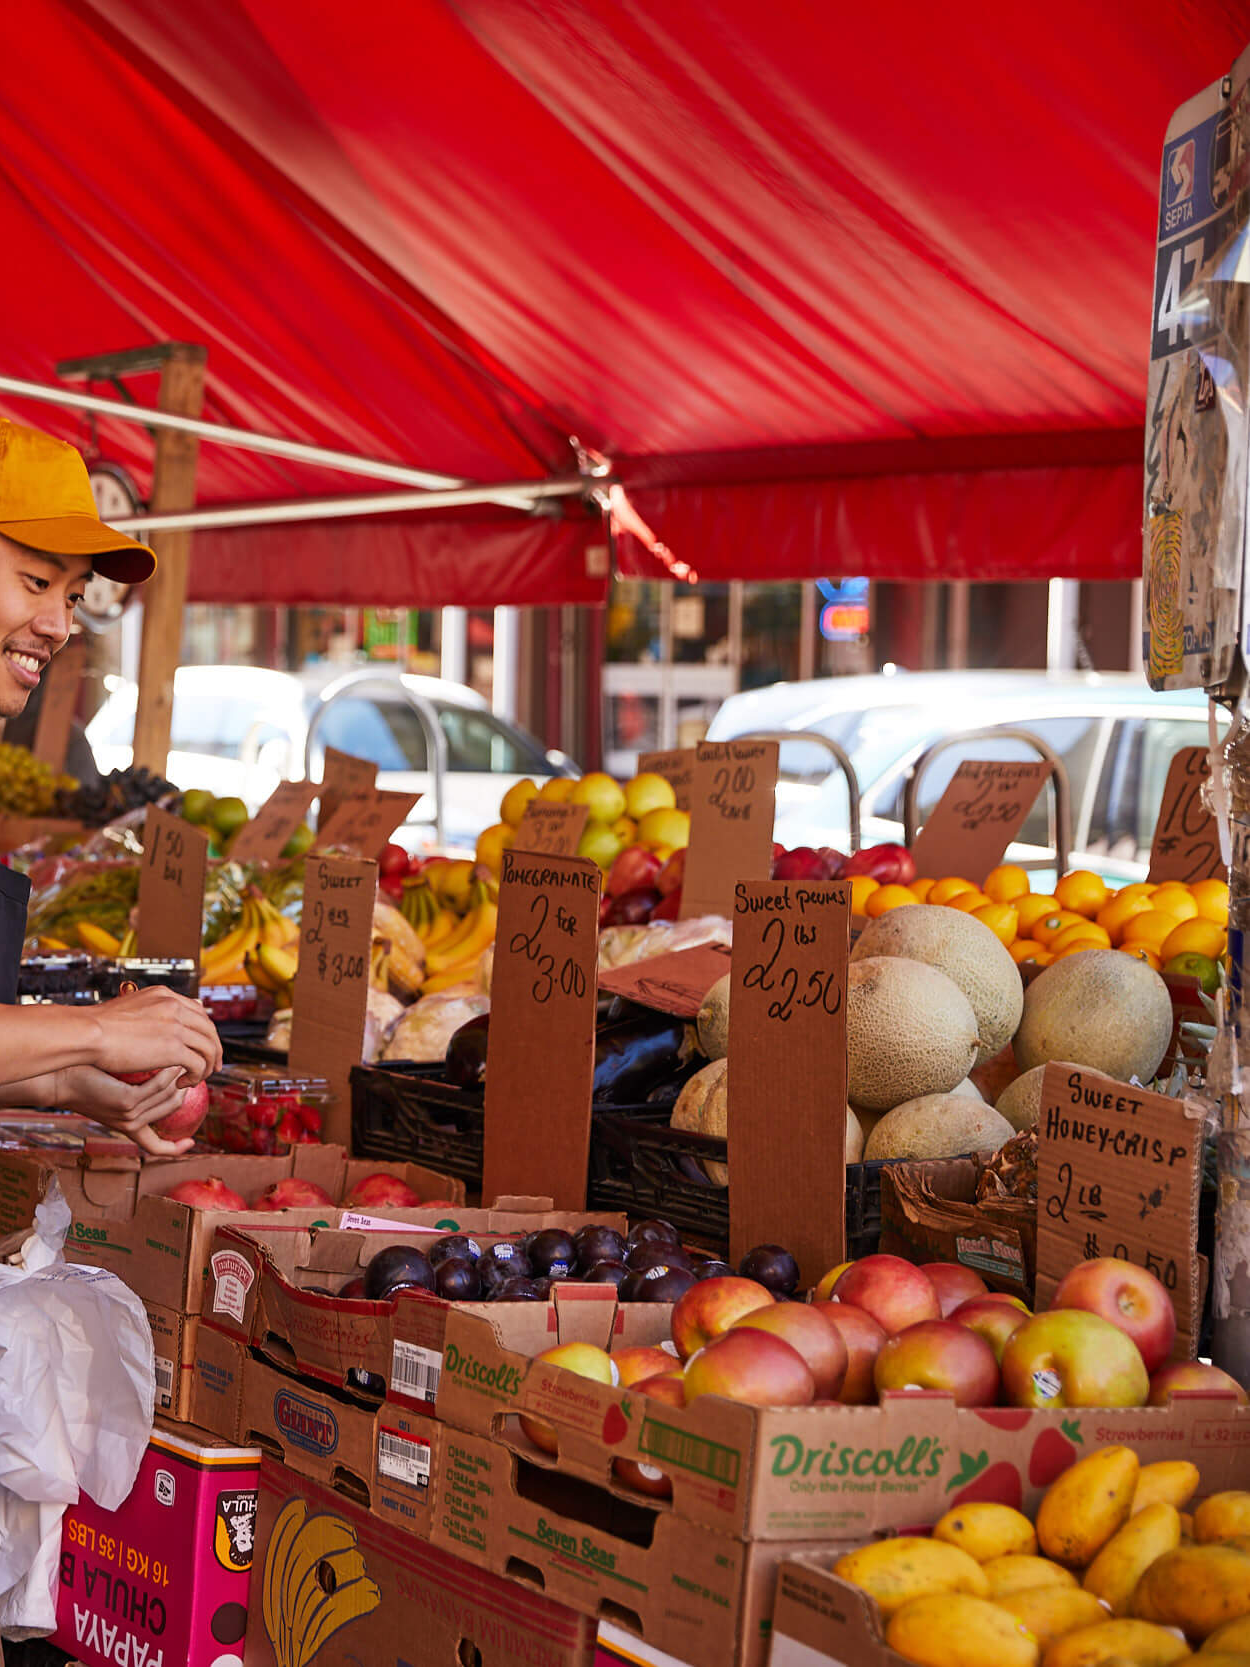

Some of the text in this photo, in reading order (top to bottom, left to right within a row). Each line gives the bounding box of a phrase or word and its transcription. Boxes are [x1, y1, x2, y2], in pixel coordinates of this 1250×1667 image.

[1165, 202, 1193, 231] SEPTA
[306, 901, 324, 944] 2
[735, 884, 793, 914] Sweet
[510, 894, 549, 960] 2
[533, 955, 586, 1003] 3.00
[743, 918, 817, 991] 2 lbs
[768, 968, 841, 1021] 2.50
[1046, 1162, 1103, 1223] 2 LB
[75, 1221, 108, 1241] Seas
[445, 1343, 523, 1396] Driscoll's
[278, 1397, 332, 1446] GIANT
[1096, 1426, 1185, 1442] Strawberries
[770, 1434, 945, 1477] Driscoll's
[222, 1500, 257, 1512] HULA
[68, 1519, 169, 1587] 16 KG 35 LBS
[537, 1517, 577, 1555] Seven
[581, 1536, 615, 1570] Seas
[83, 1560, 167, 1636] CHULA
